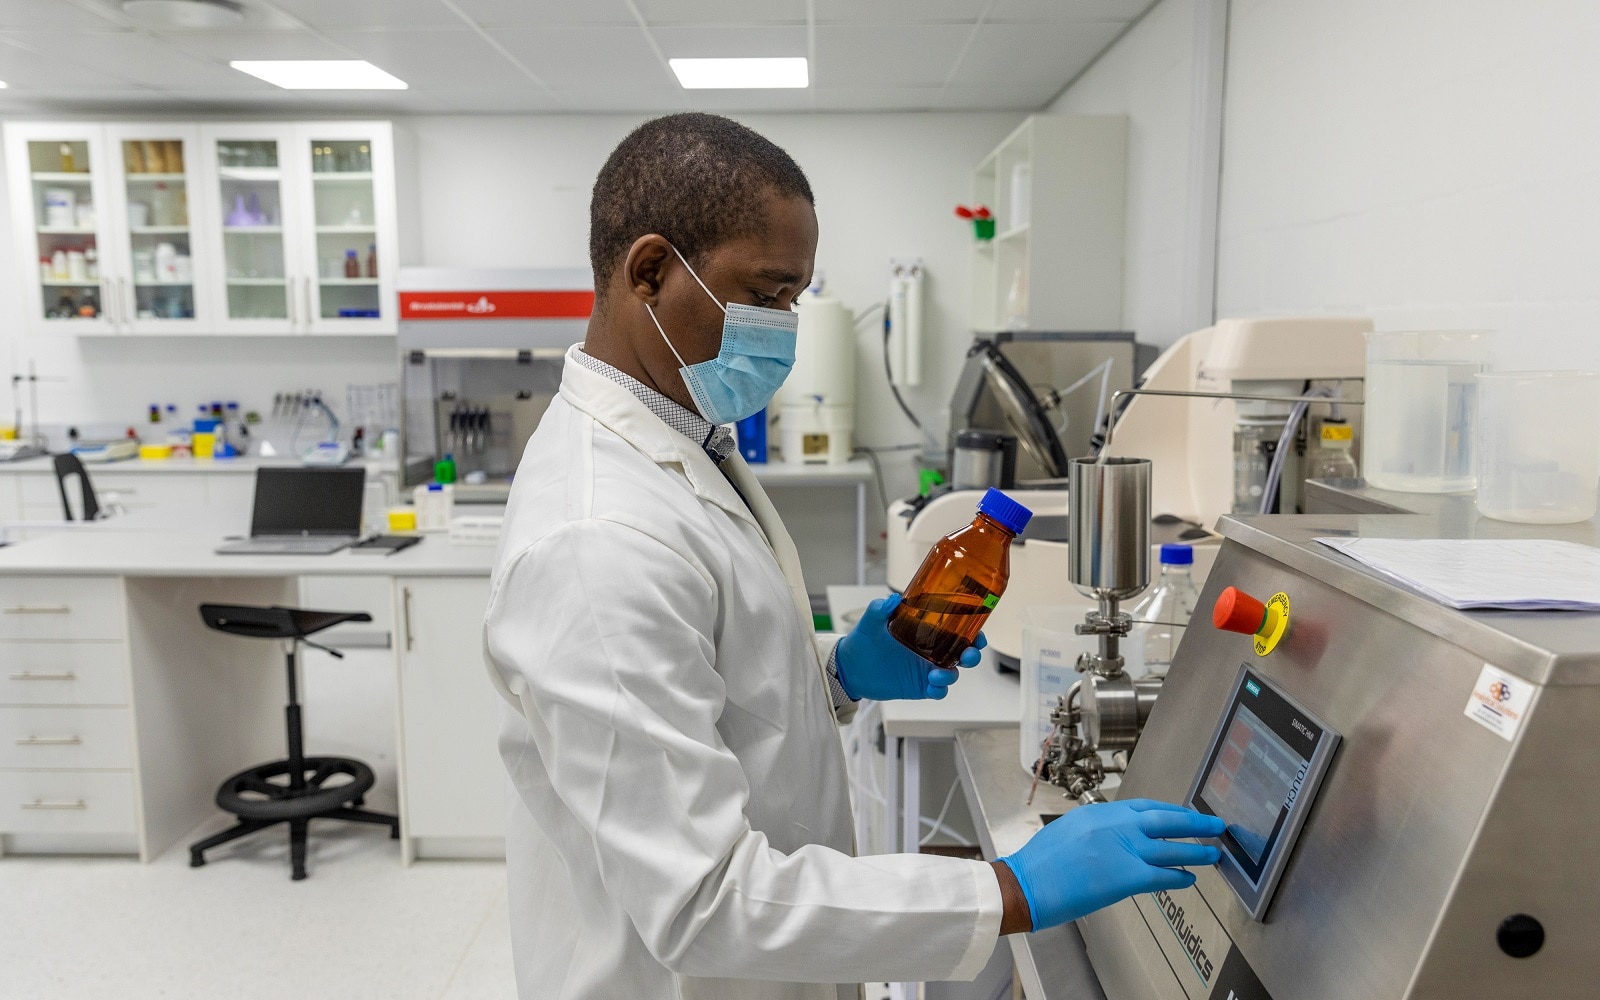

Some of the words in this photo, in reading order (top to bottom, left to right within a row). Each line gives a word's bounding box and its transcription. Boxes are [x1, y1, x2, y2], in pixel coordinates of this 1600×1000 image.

[1267, 594, 1288, 616] EMERGENCY
[1255, 641, 1266, 654] STOP
[1291, 718, 1307, 735] SIMATIC
[1284, 764, 1309, 809] TOUCH
